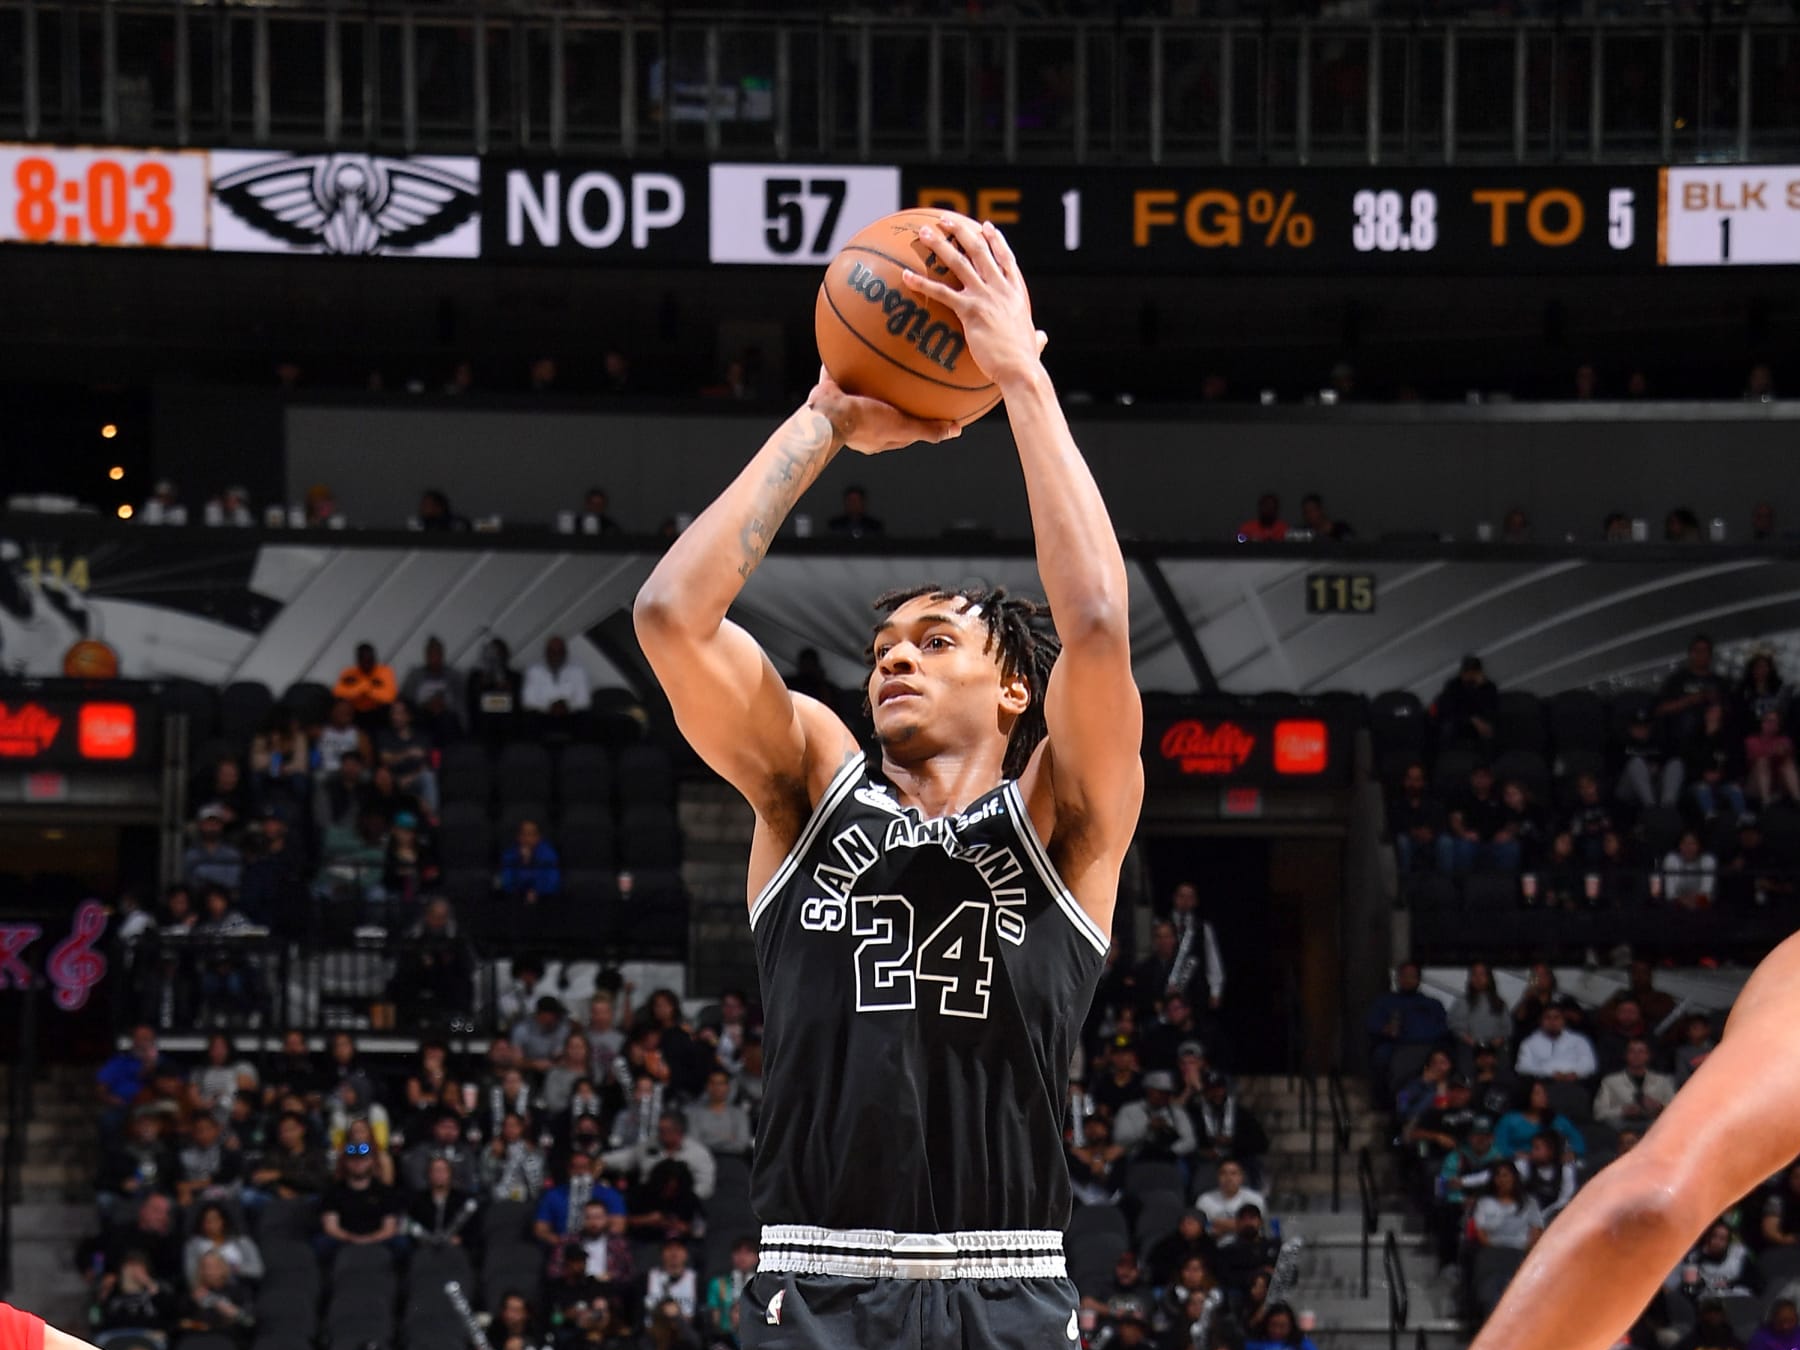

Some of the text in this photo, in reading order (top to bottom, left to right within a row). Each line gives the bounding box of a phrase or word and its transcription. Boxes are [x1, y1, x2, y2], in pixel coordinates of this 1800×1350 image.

[15, 155, 175, 244] 8:03
[507, 170, 686, 249] NOP
[763, 178, 848, 255] 57
[1062, 189, 1081, 251] 1
[1133, 189, 1314, 247] FG%
[1353, 189, 1437, 251] 38.8
[1471, 188, 1585, 247] TO
[1608, 187, 1634, 250] 5
[1682, 180, 1767, 211] BLK
[1719, 216, 1731, 262] 1
[847, 259, 968, 372] Wilson
[25, 557, 90, 592] 114
[1312, 576, 1373, 611] 115
[800, 823, 881, 932] SAN
[850, 894, 994, 1020] 24
